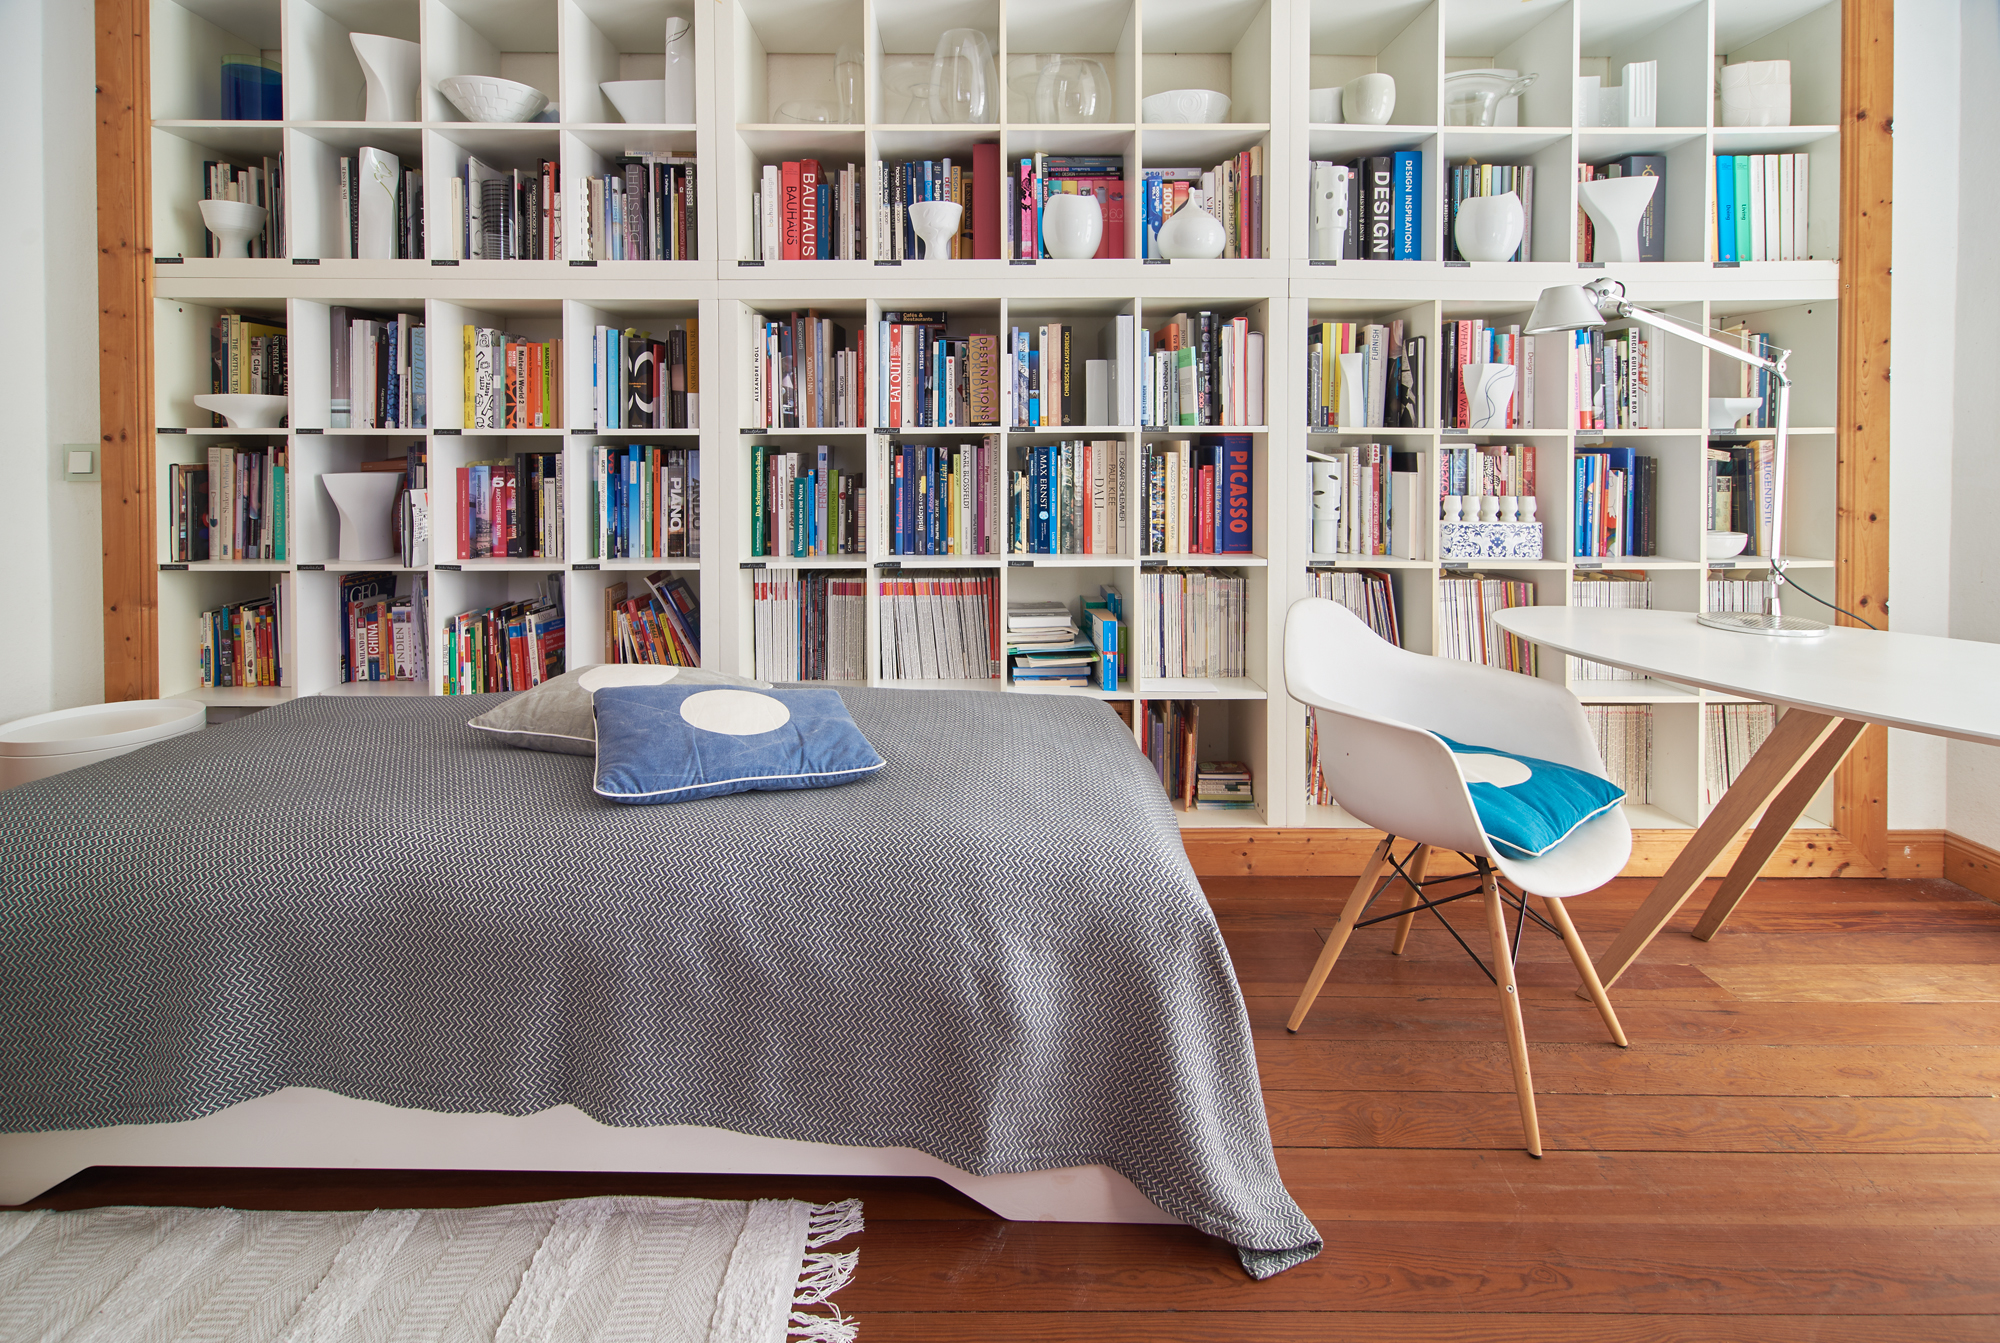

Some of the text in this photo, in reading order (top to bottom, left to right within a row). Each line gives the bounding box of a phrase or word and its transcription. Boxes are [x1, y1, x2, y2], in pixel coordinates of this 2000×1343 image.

[342, 166, 350, 200] DAS MESSER
[629, 166, 640, 242] DER STUHL
[933, 179, 942, 202] Design
[1163, 187, 1172, 215] 1000
[787, 186, 798, 246] BAUHAUS
[803, 173, 815, 256] BAUHAUS
[1228, 222, 1234, 230] OF
[1373, 171, 1390, 254] DESIGN
[1405, 160, 1413, 254] DESIGN INSPIRATIONS
[1358, 225, 1366, 241] KUNST
[797, 320, 805, 350] Giacometti
[1459, 323, 1468, 351] WHAT
[251, 358, 260, 376] Clay
[414, 330, 425, 391] BÖTTGER
[890, 357, 901, 403] EAT OUT!
[972, 338, 982, 420] WORLDWIDE
[979, 337, 990, 420] DESTINATIONS
[981, 337, 997, 420] DESIGN
[1526, 351, 1534, 375] Design
[1459, 398, 1468, 418] WAS
[818, 467, 827, 509] FENG SHUI
[963, 450, 971, 509] KARL BLOSSFELDT
[1040, 454, 1048, 509] MAX ERNST
[1108, 463, 1116, 506] PAUL KLEE
[1229, 450, 1248, 533] PICASSO
[1762, 460, 1772, 526] JUGENDSTIL
[671, 477, 682, 531] PIANO
[692, 477, 700, 531] ANDO
[367, 623, 379, 654] CHINA
[395, 626, 405, 664] INDIEN
[649, 619, 658, 639] ZYPERN
